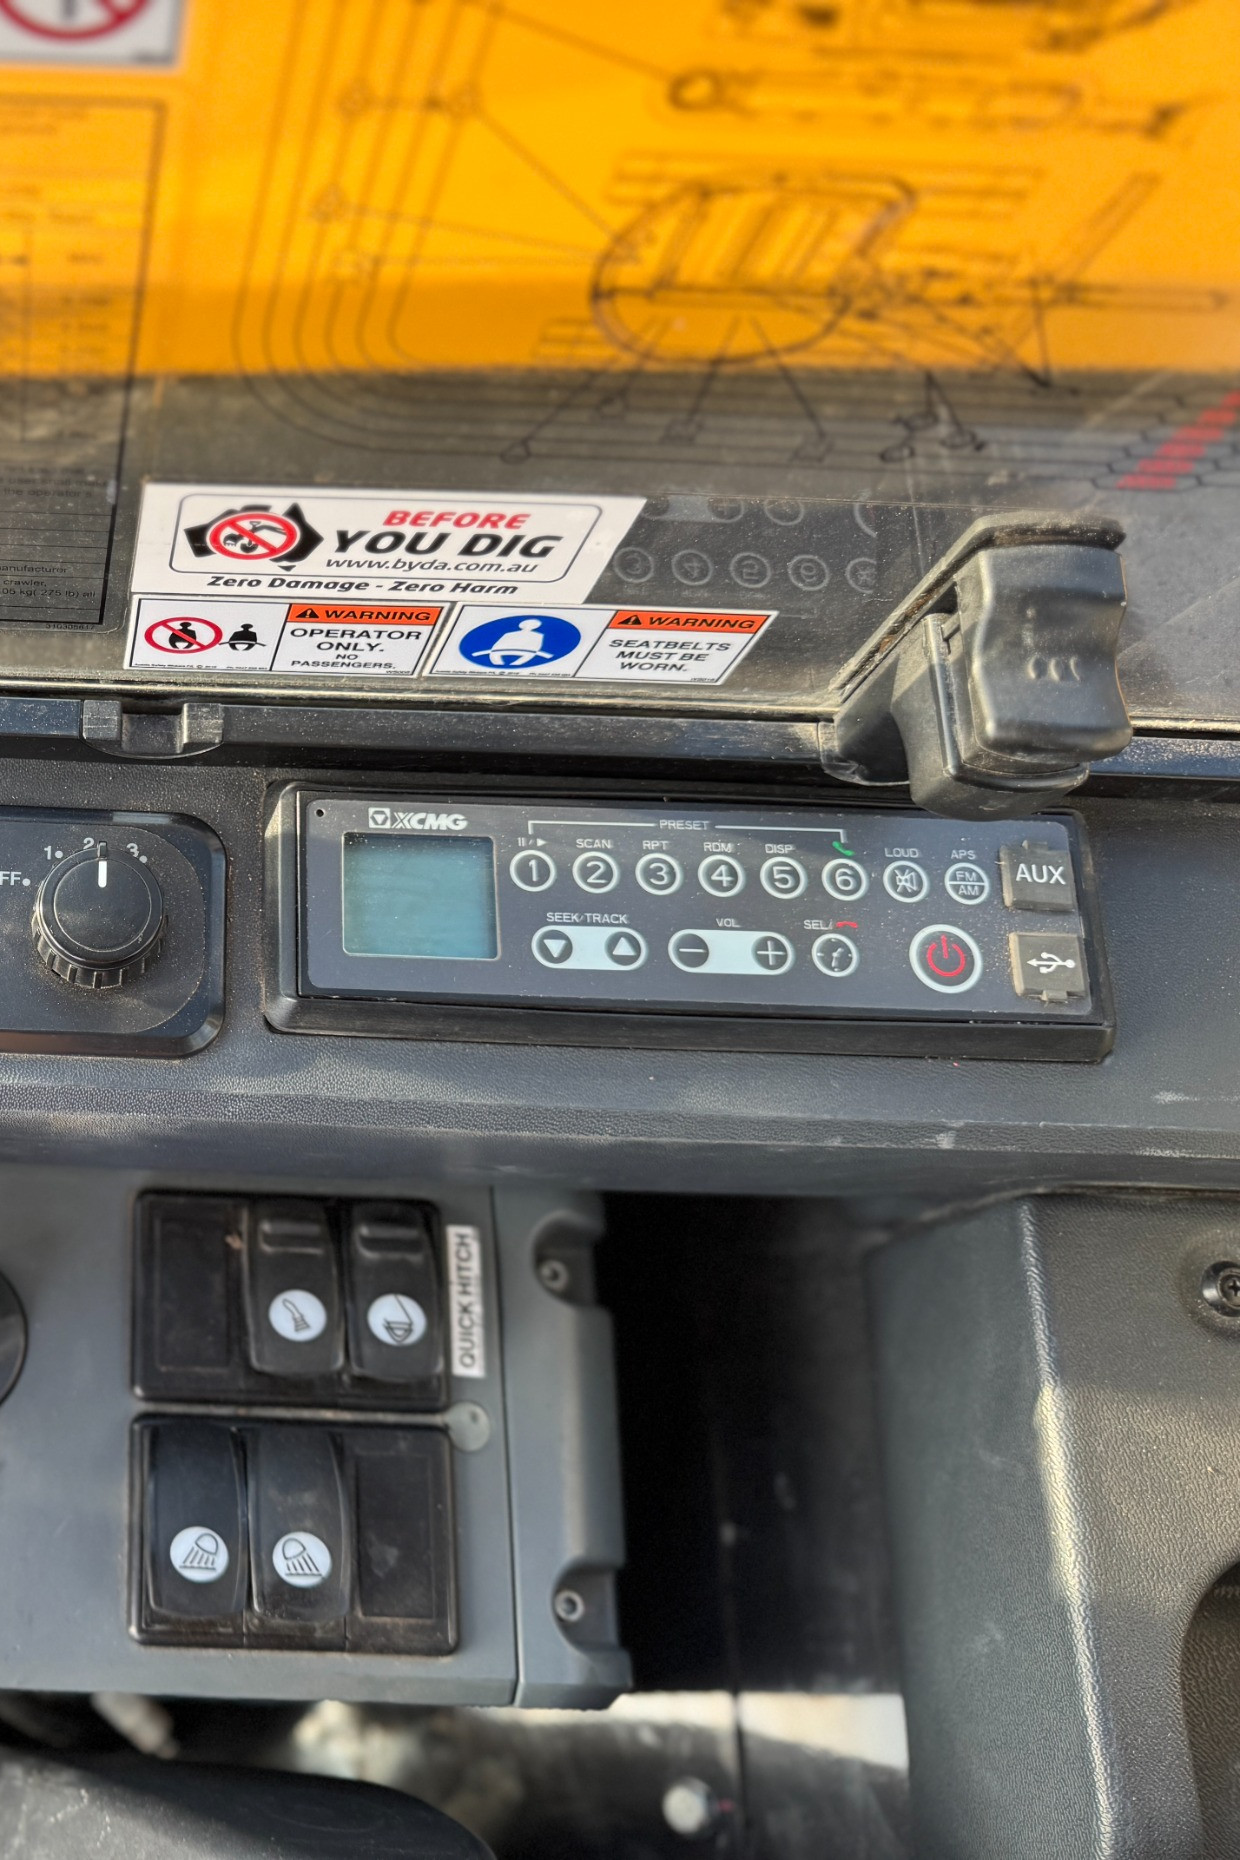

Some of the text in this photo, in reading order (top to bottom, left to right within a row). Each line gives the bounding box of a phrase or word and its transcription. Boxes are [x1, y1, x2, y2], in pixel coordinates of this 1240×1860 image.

[382, 510, 531, 530] BEFORE
[334, 529, 564, 558] YOU DIG
[326, 558, 538, 573] www.byda.com.au
[207, 576, 262, 588] Zero
[267, 577, 370, 593] Damage
[388, 581, 445, 593] Zero
[450, 582, 518, 595] Harm
[325, 609, 431, 621] WARNING
[649, 616, 756, 629] WARNING
[290, 628, 422, 640] OPERATOR
[316, 641, 384, 652] ONLY.
[608, 639, 731, 651] SEATBELTS
[615, 651, 710, 662] MUST BE
[291, 660, 396, 669] PASSENGERS.
[620, 661, 688, 672] WORN.
[391, 812, 469, 831] XCMG
[659, 819, 710, 831] PRESET
[83, 837, 95, 850] 2
[126, 842, 140, 857] 3
[575, 838, 611, 849] SCAN
[643, 840, 669, 850] RPT
[703, 842, 732, 852] RDM
[764, 844, 794, 854] DISP
[44, 845, 52, 860] 1
[884, 847, 920, 858] LOUD
[950, 850, 976, 860] APS
[528, 859, 538, 882] 1
[586, 861, 608, 883] 2
[649, 862, 669, 885] 3
[710, 864, 734, 887] 4
[955, 870, 977, 882] FM
[1015, 863, 1066, 885] AUX
[772, 865, 793, 889] 5
[835, 868, 856, 890] 6
[958, 886, 979, 896] AM
[546, 912, 628, 924] SEEK/TRACK
[716, 918, 740, 928] VOL
[455, 1232, 476, 1369] QUICK HITCH
